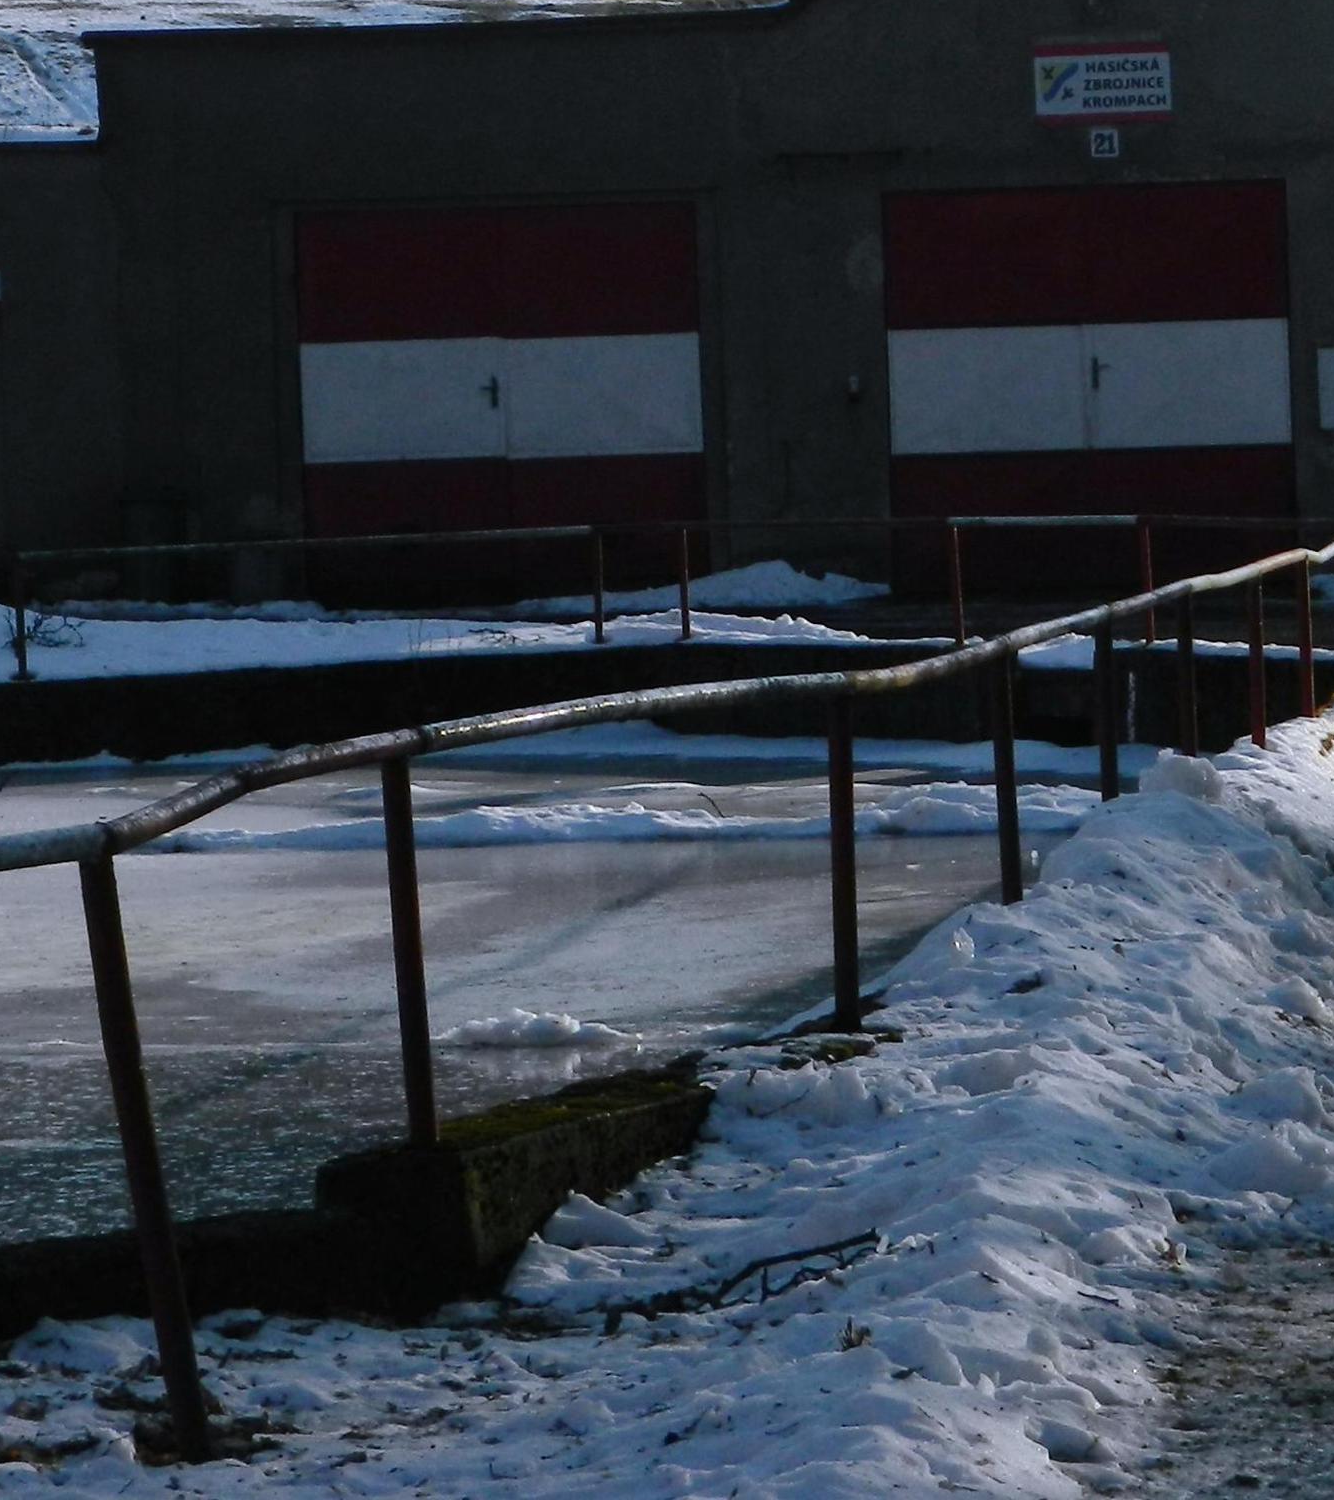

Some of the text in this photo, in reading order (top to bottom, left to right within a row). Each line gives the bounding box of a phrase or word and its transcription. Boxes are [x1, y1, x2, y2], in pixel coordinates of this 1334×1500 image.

[1085, 57, 1160, 73] HASIČSKÁ
[1083, 76, 1165, 91] ZBROJNICE
[1082, 94, 1167, 109] KROMPACH
[1094, 133, 1116, 154] 21
